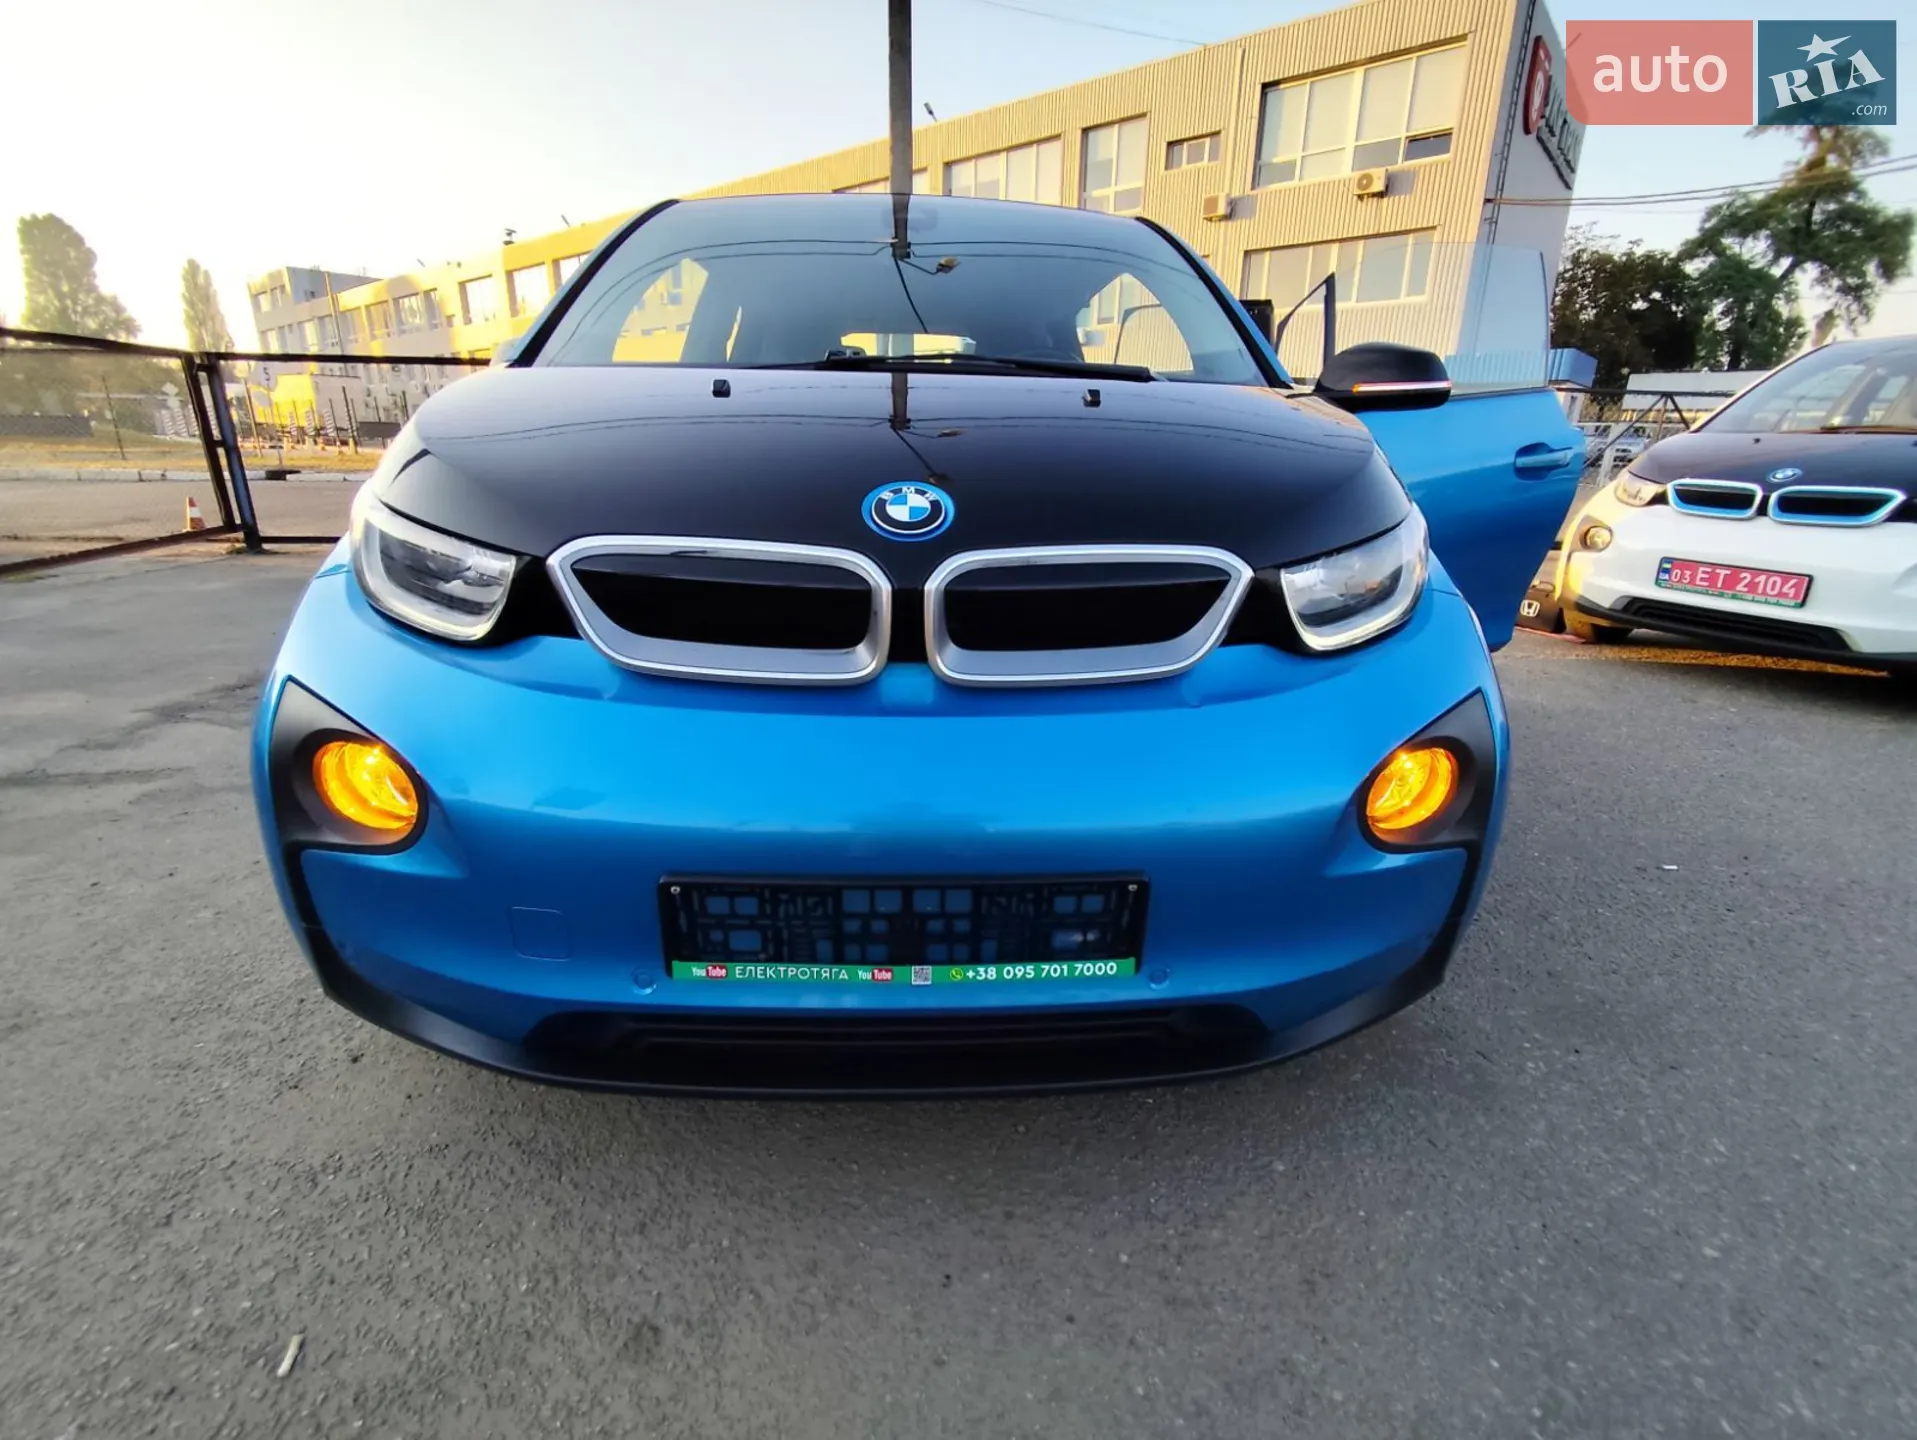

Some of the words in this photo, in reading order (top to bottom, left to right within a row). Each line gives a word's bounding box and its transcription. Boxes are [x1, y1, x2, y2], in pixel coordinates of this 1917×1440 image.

[880, 486, 938, 501] BMW
[1671, 569, 1691, 583] 03
[1695, 567, 1731, 588] ET
[1735, 572, 1798, 598] 2104
[735, 966, 848, 980] ЕЛЕКТРОТЯГА
[966, 967, 997, 980] +38
[1003, 966, 1035, 979] 095
[1041, 965, 1068, 978] 701
[1074, 962, 1117, 976] 7000
